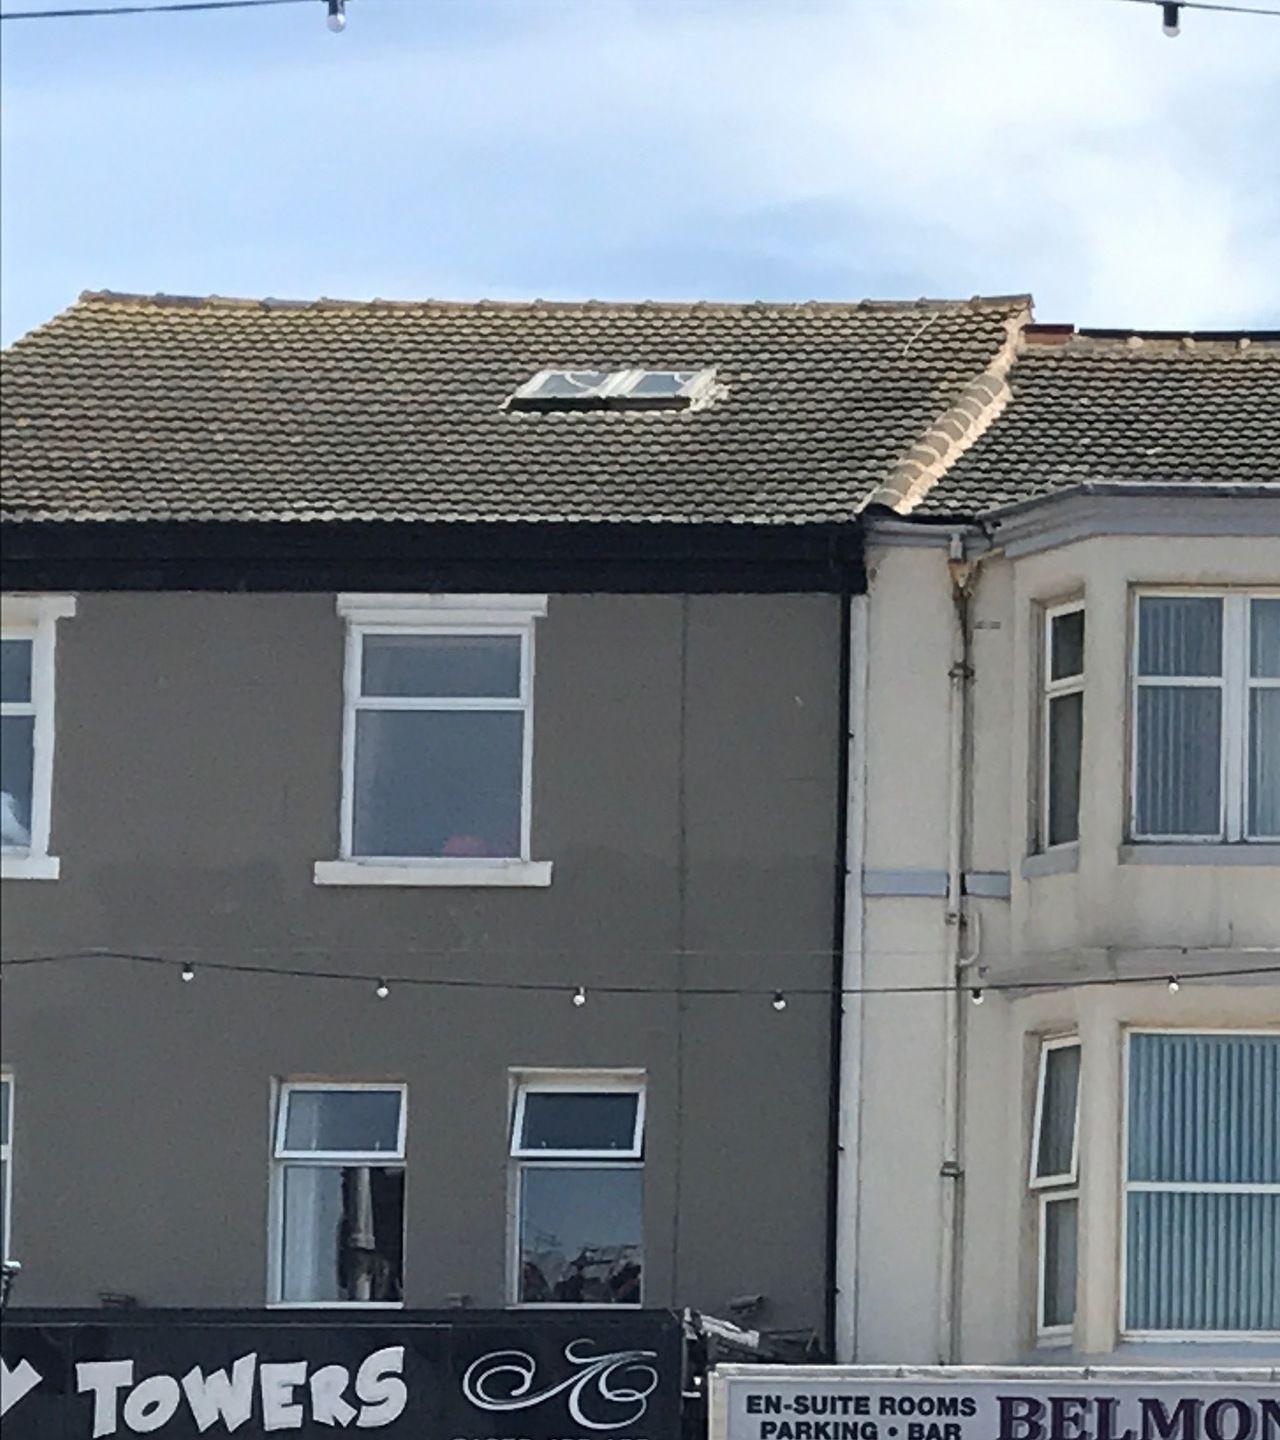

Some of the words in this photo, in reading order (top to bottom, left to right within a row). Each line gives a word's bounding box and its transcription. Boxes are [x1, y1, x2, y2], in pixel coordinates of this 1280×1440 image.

[76, 1346, 408, 1439] TOWERS
[746, 1394, 871, 1416] EN-SUITE
[878, 1396, 977, 1417] ROOMS
